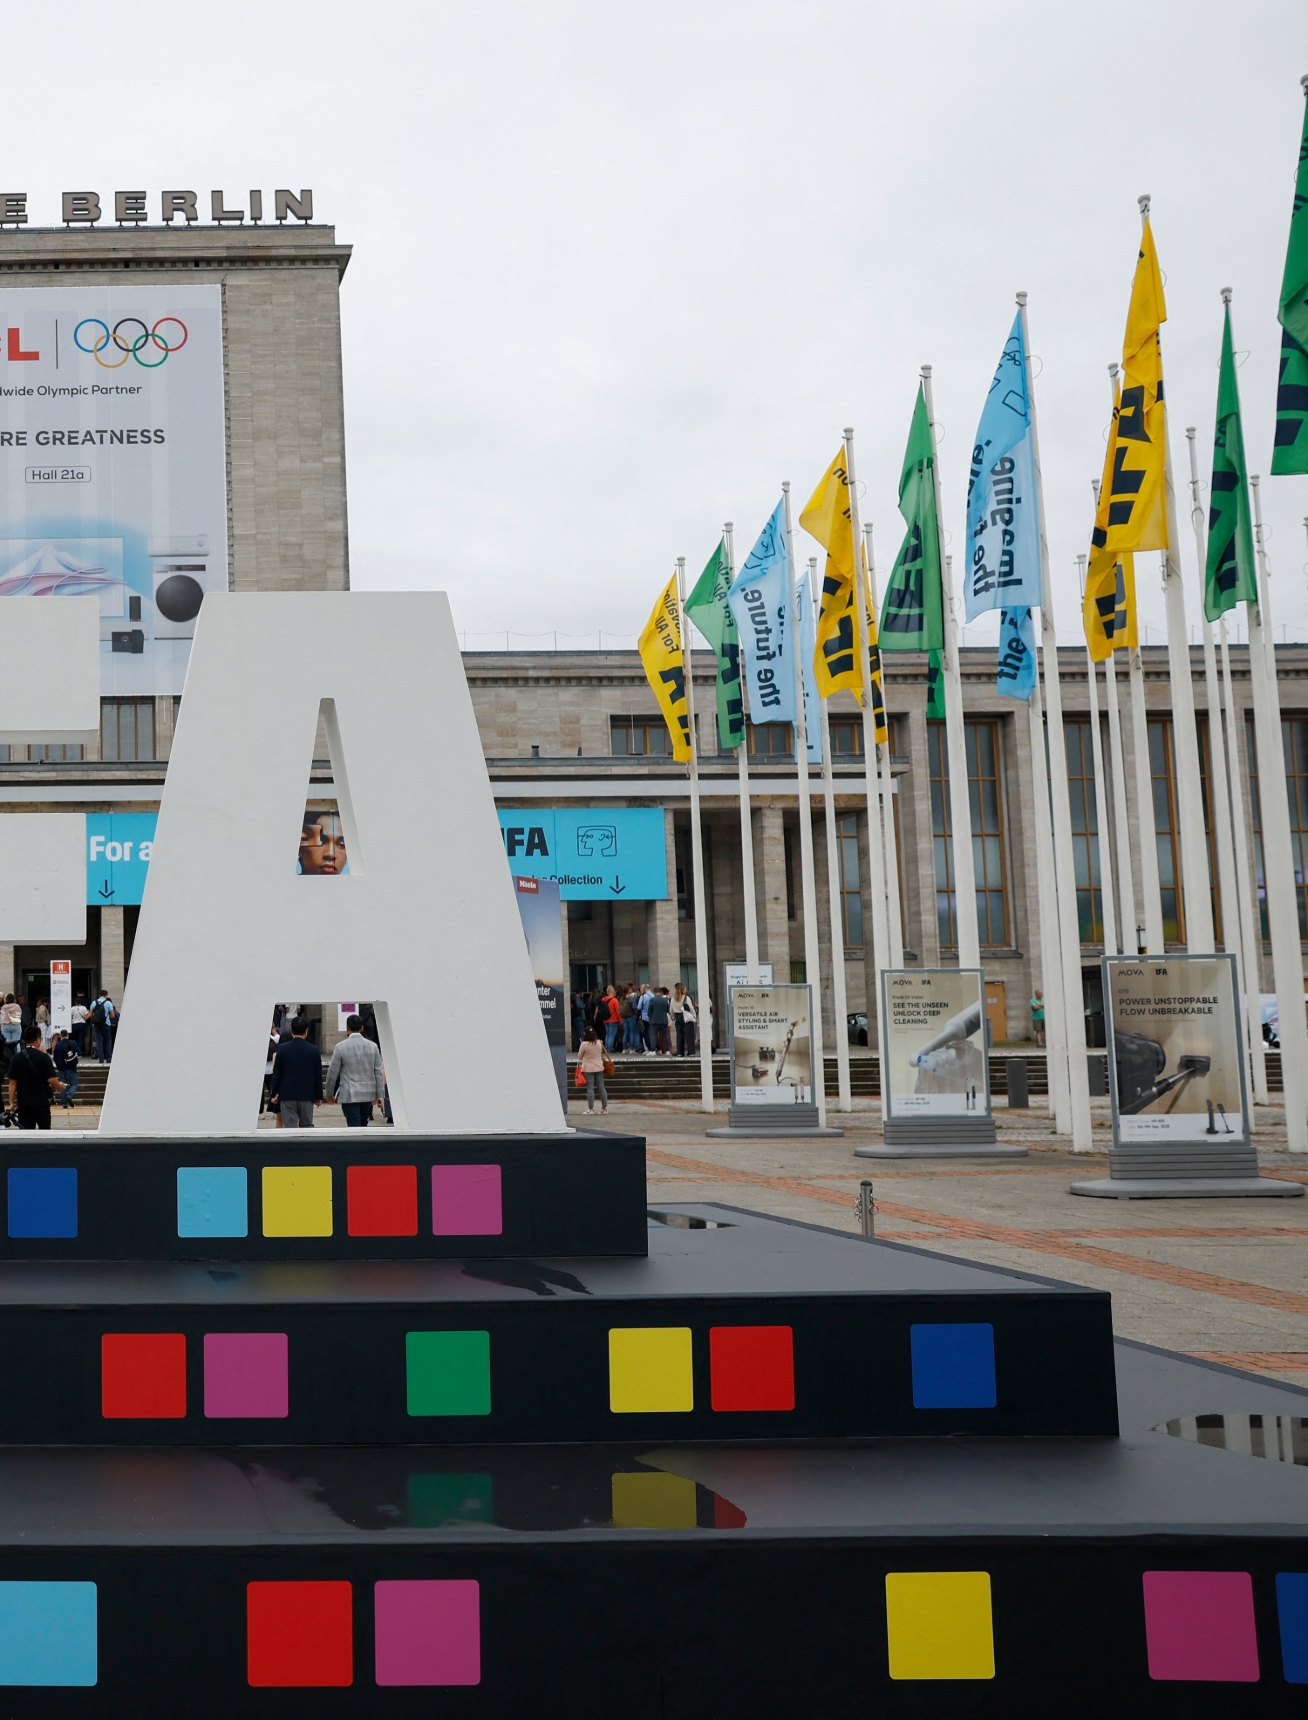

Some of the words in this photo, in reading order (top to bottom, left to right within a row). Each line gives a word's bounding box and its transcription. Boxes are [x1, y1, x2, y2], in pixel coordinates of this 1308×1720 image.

[62, 189, 313, 224] BERLIN
[37, 385, 88, 400] Olympic
[91, 384, 142, 397] Partner
[35, 429, 165, 447] GREATNESS
[32, 469, 57, 481] Hall
[61, 469, 85, 481] 21a
[998, 637, 1027, 680] the
[90, 836, 133, 862] For
[519, 880, 537, 889] Miele
[1155, 968, 1168, 976] IFA
[1119, 998, 1152, 1006] POWER
[1154, 997, 1218, 1005] UNSTOPPABLE
[1120, 1008, 1146, 1016] FLOW
[1148, 1007, 1213, 1015] UNBREAKABLE
